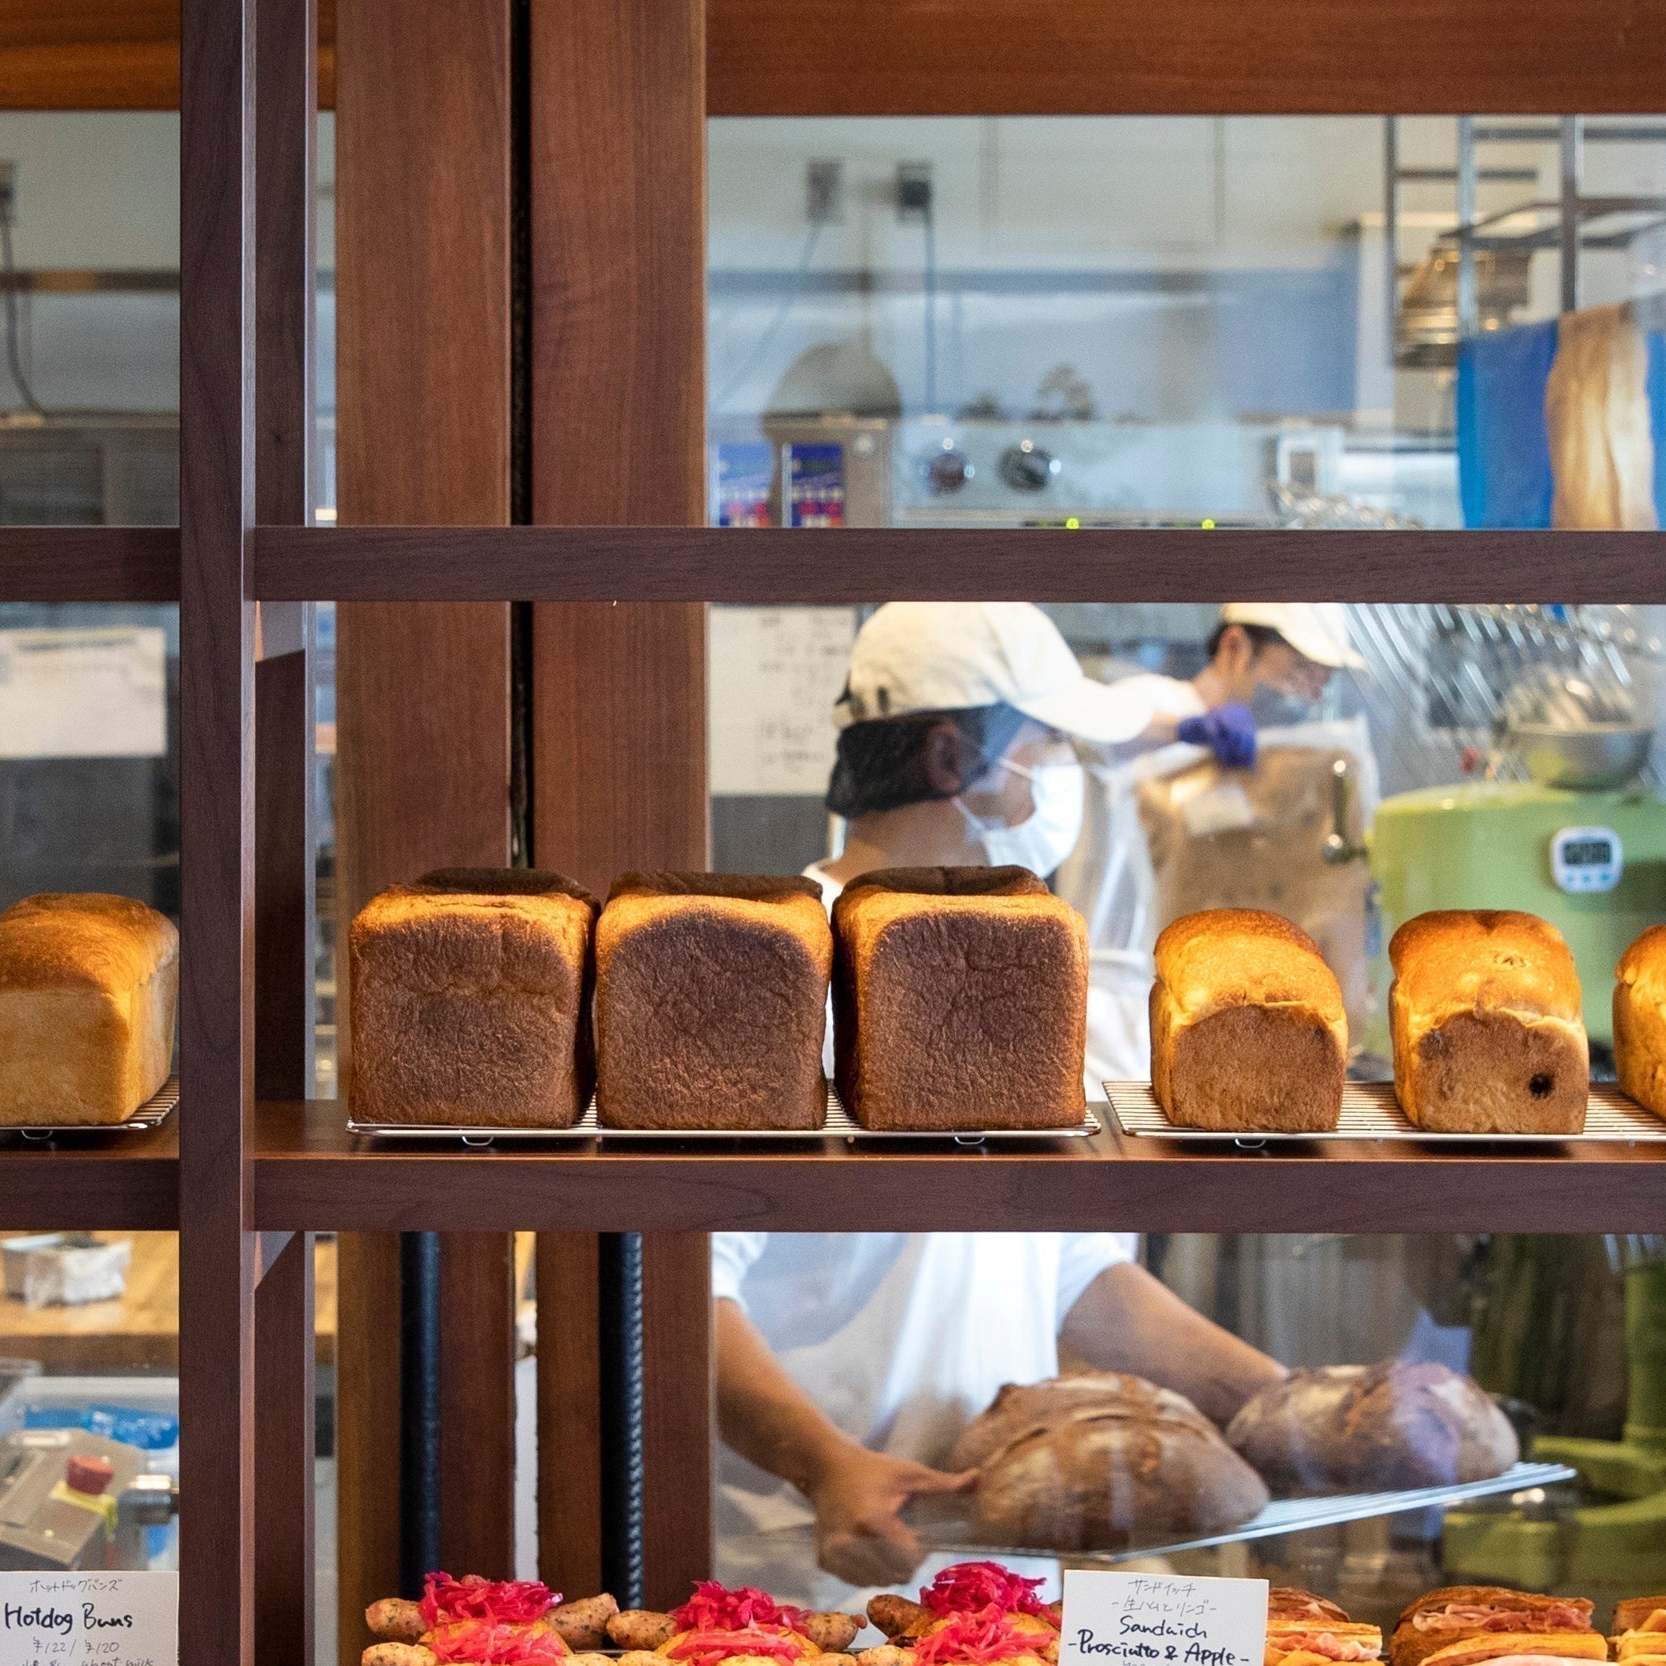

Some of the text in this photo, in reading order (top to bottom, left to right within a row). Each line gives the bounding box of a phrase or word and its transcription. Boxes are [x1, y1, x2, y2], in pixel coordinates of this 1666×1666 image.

[5, 1603, 133, 1635] Hotdog Buns
[1165, 1646, 1178, 1660] &
[1184, 1642, 1235, 1666] Apple
